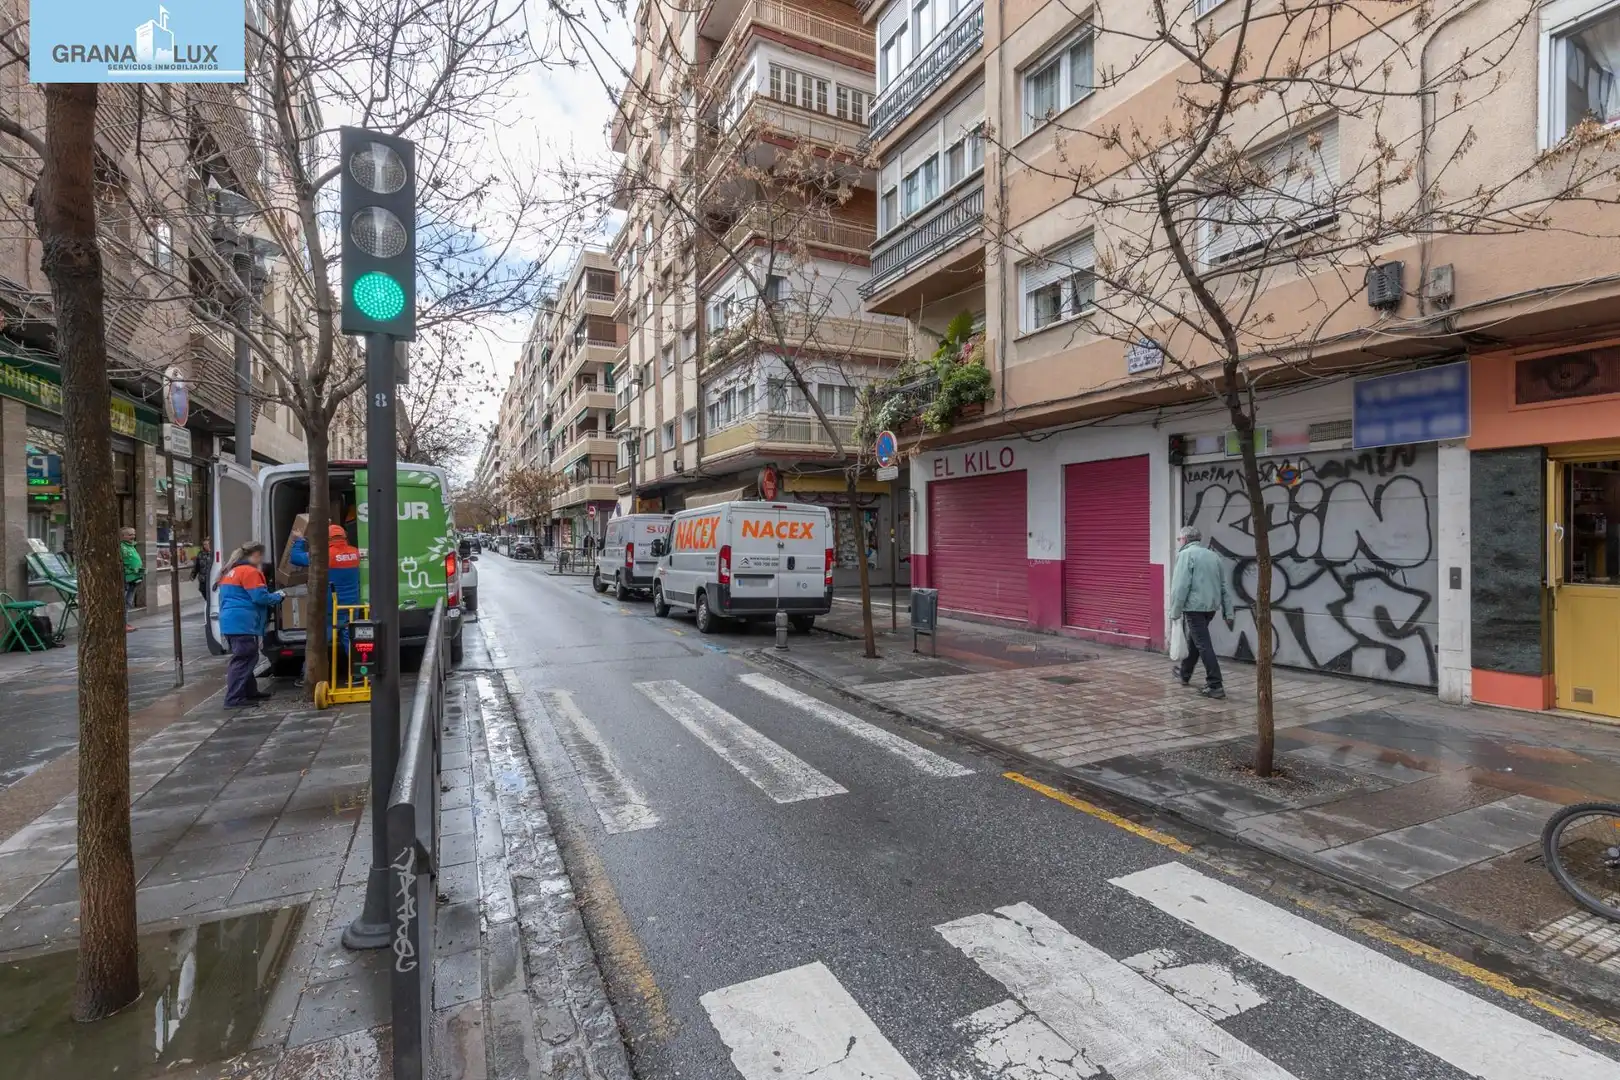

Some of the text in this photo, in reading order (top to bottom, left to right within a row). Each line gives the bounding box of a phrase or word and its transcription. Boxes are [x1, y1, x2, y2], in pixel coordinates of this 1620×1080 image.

[933, 446, 1014, 477] EL KILO
[357, 502, 430, 523] SUR
[676, 516, 721, 550] NACEX
[741, 519, 815, 540] NACEX
